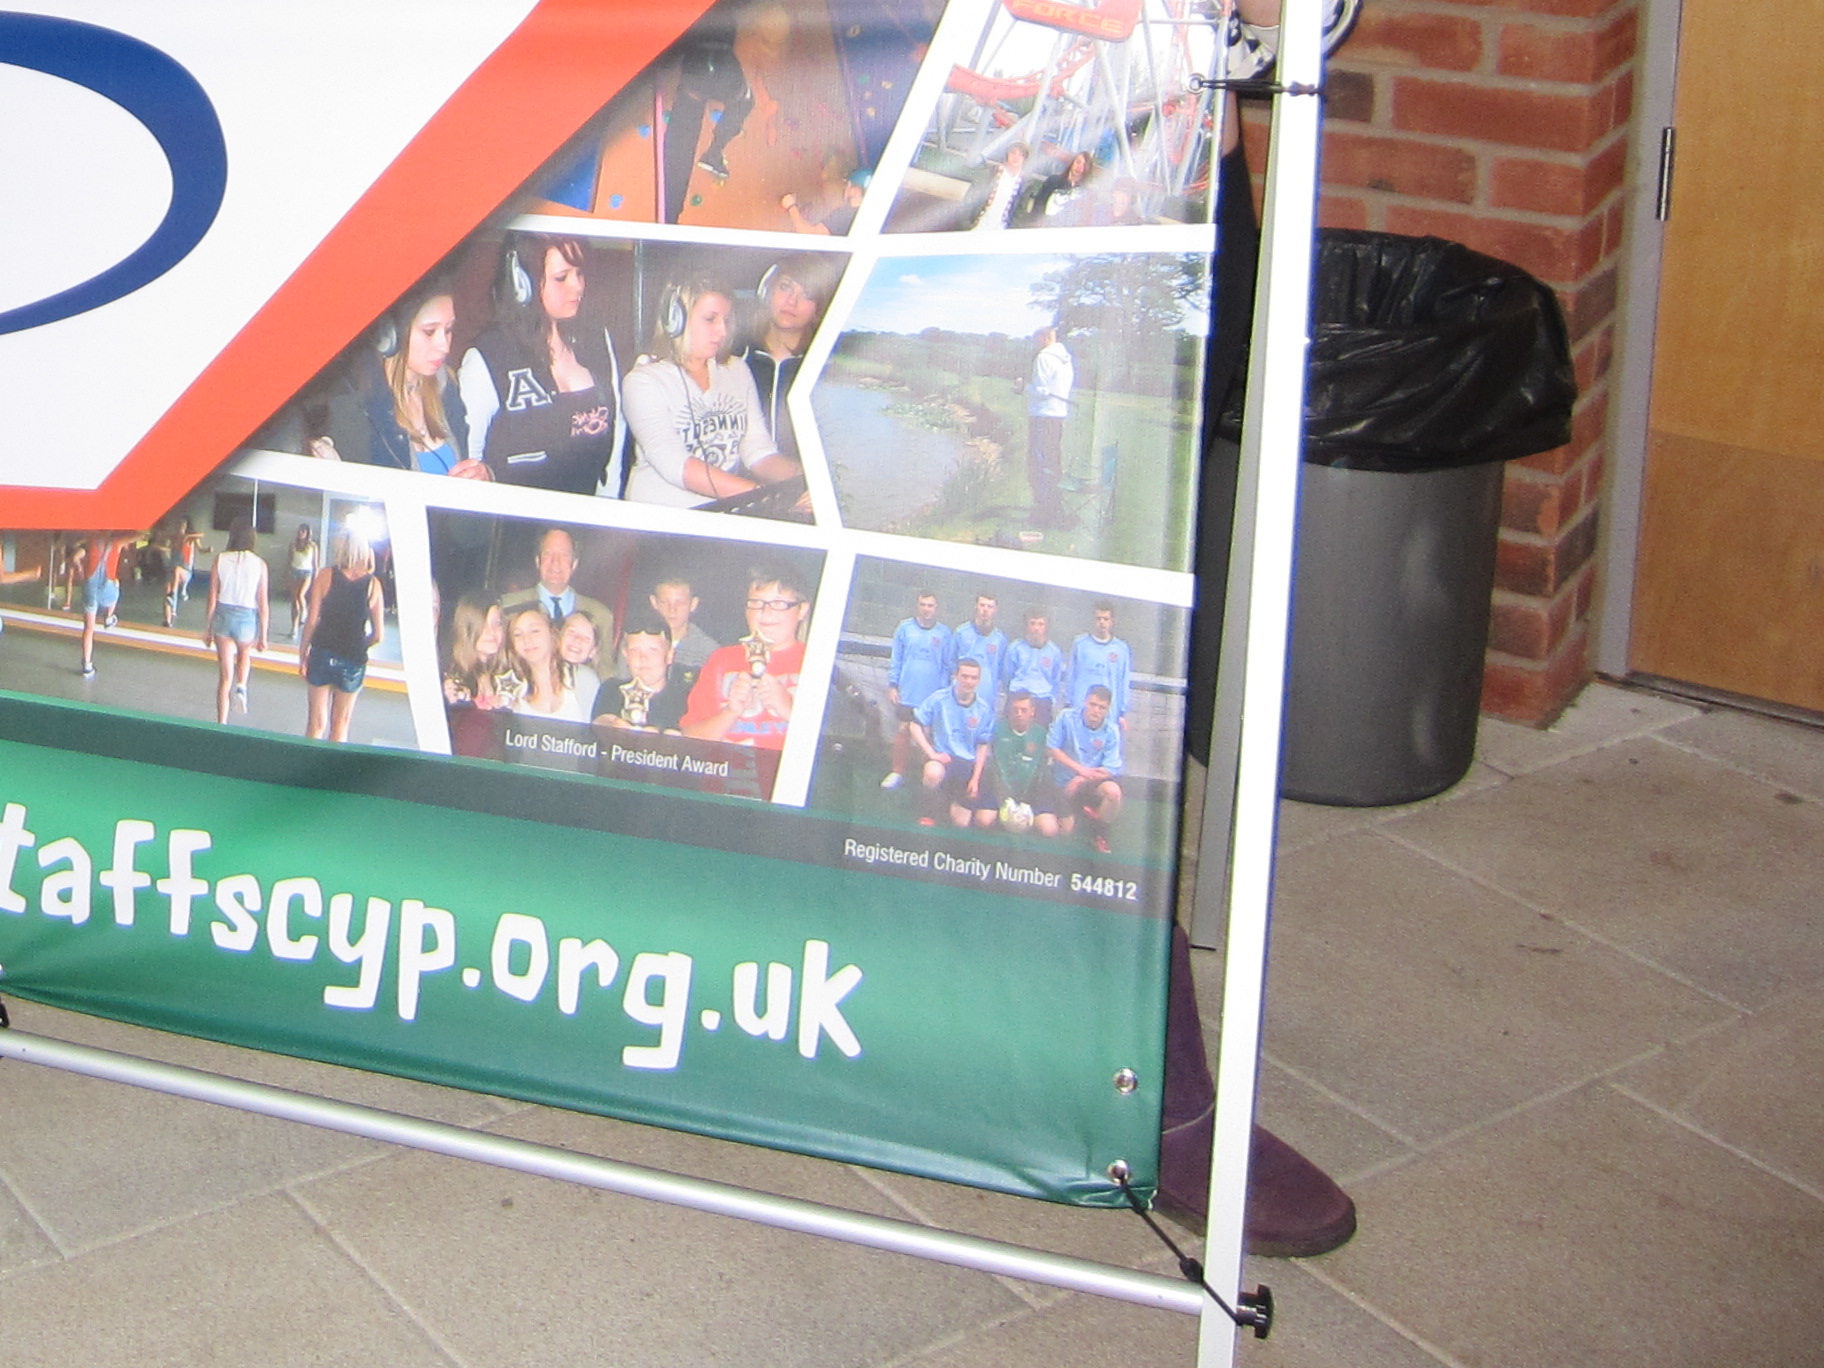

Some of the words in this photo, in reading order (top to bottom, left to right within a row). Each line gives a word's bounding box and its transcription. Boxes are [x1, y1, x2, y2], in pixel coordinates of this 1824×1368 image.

[505, 729, 537, 750] Lord
[541, 734, 597, 759] Stafford
[611, 744, 678, 771] President
[681, 754, 729, 777] Award
[844, 838, 930, 869] Registered
[933, 851, 991, 881] Charity
[995, 862, 1062, 889] Number
[1070, 873, 1138, 901] 544812
